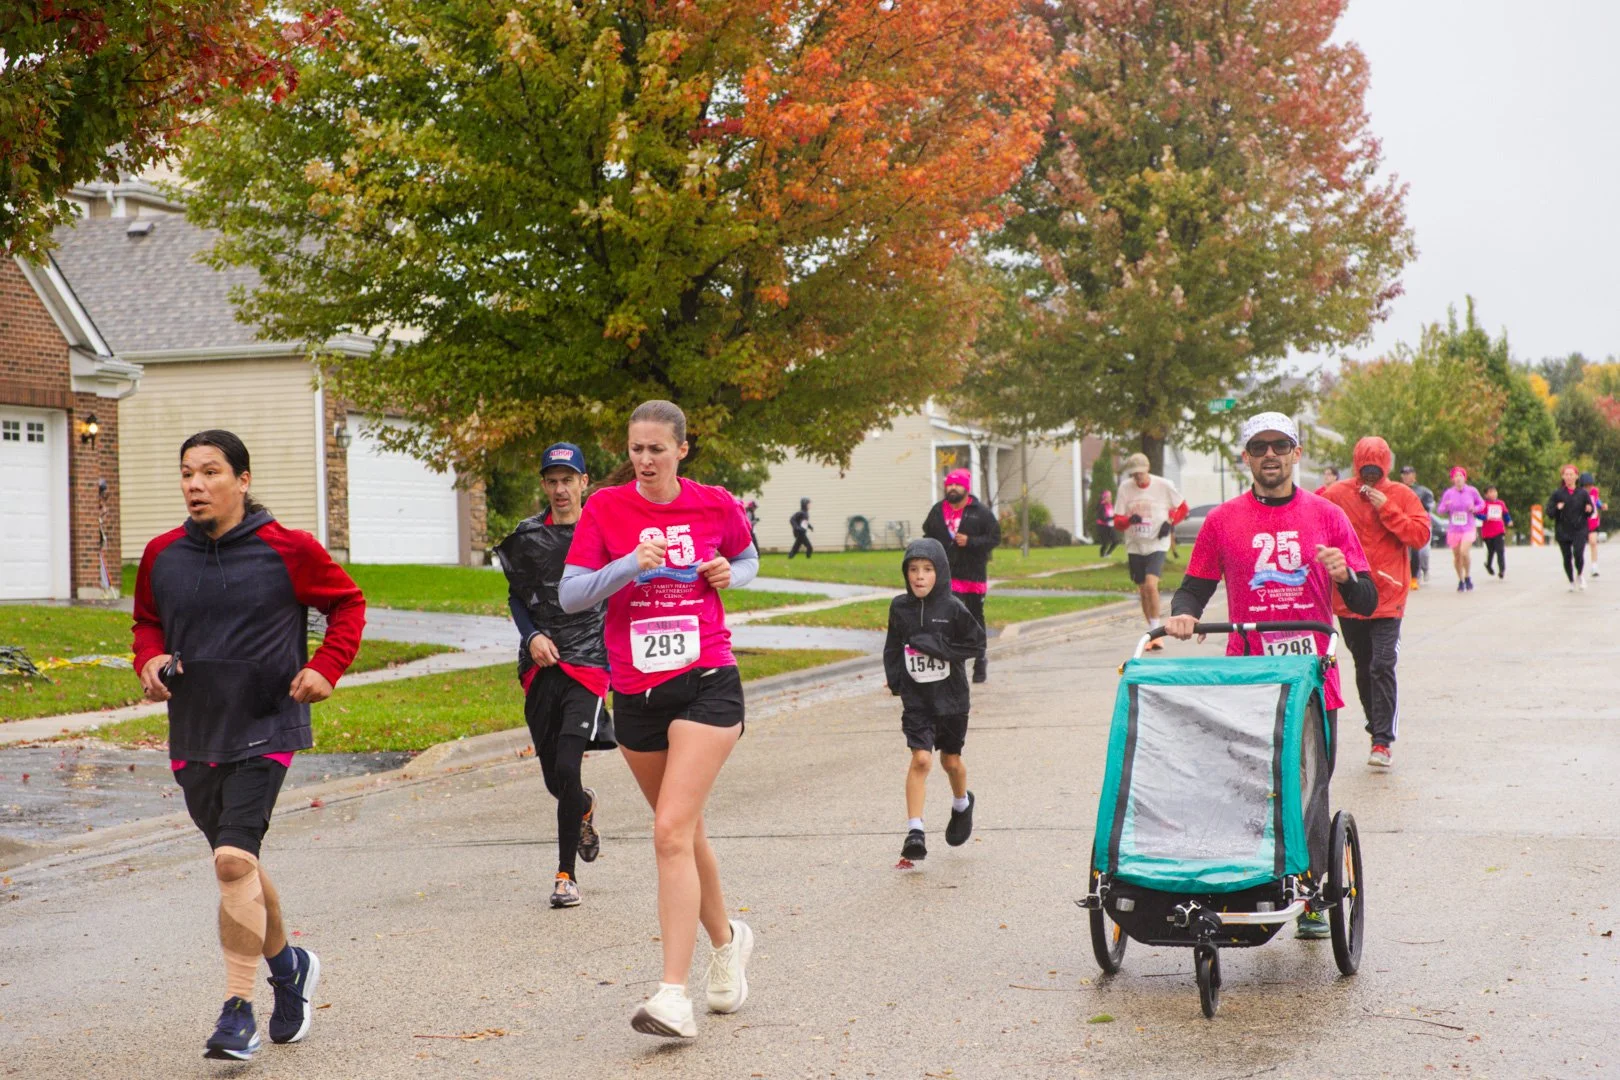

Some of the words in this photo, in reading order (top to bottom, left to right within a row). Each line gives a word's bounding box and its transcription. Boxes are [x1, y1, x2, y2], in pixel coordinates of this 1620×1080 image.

[1252, 531, 1302, 572] 25
[644, 633, 686, 658] 293
[1267, 638, 1313, 656] 1298
